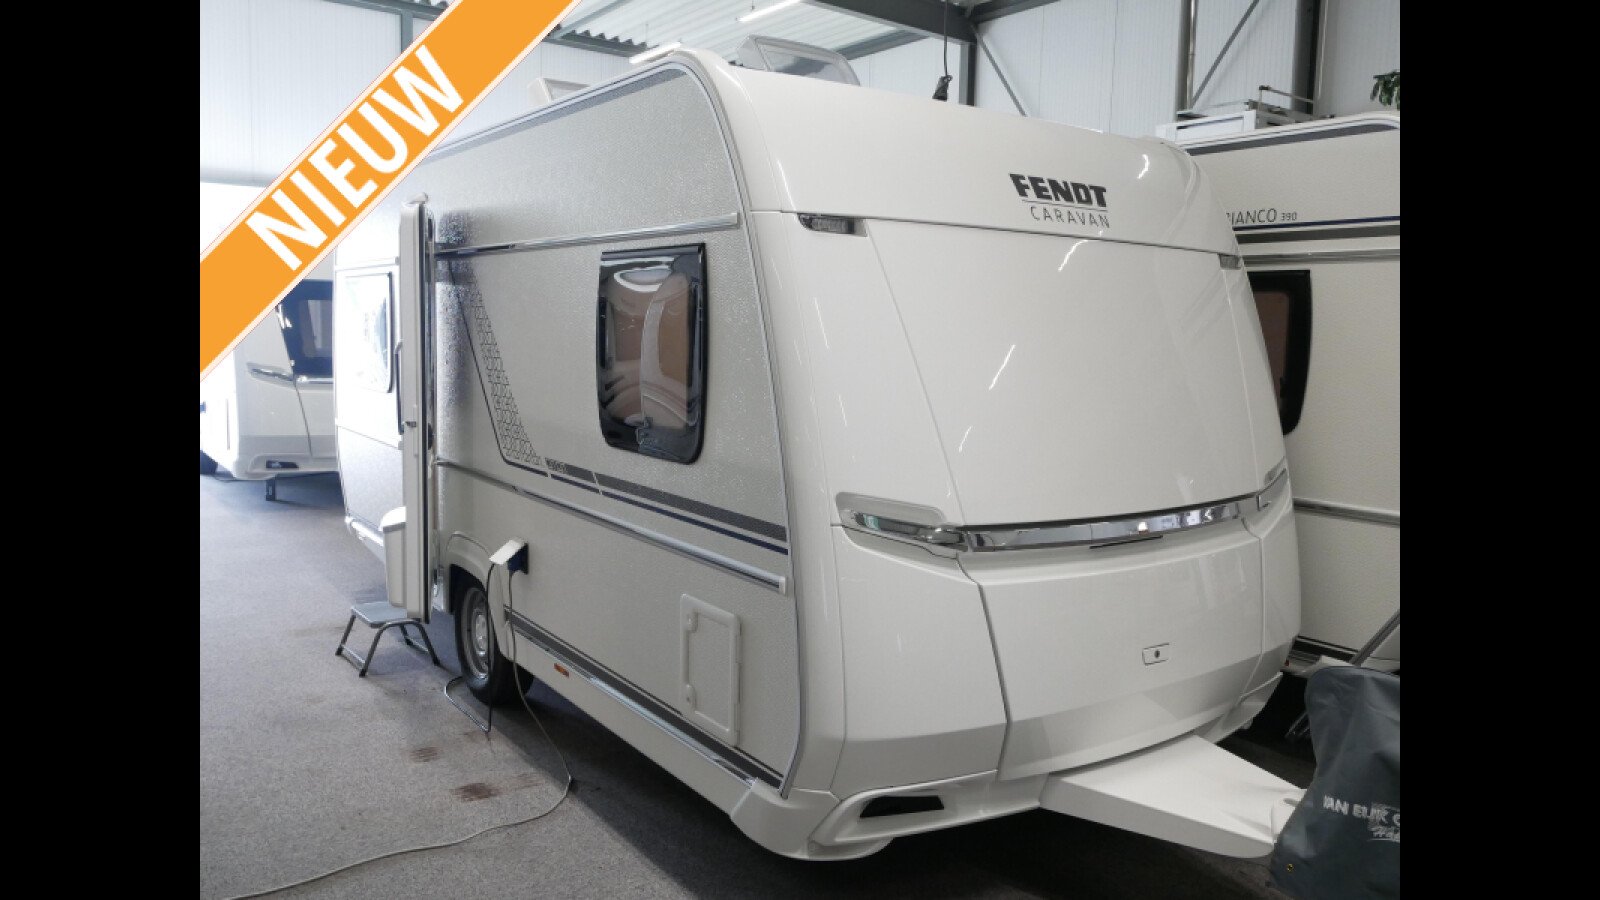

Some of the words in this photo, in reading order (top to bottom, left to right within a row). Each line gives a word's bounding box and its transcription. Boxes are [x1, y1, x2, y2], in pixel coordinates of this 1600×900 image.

[1009, 173, 1107, 207] FENDT
[1030, 206, 1110, 228] CARAVAN
[1281, 211, 1298, 221] 390
